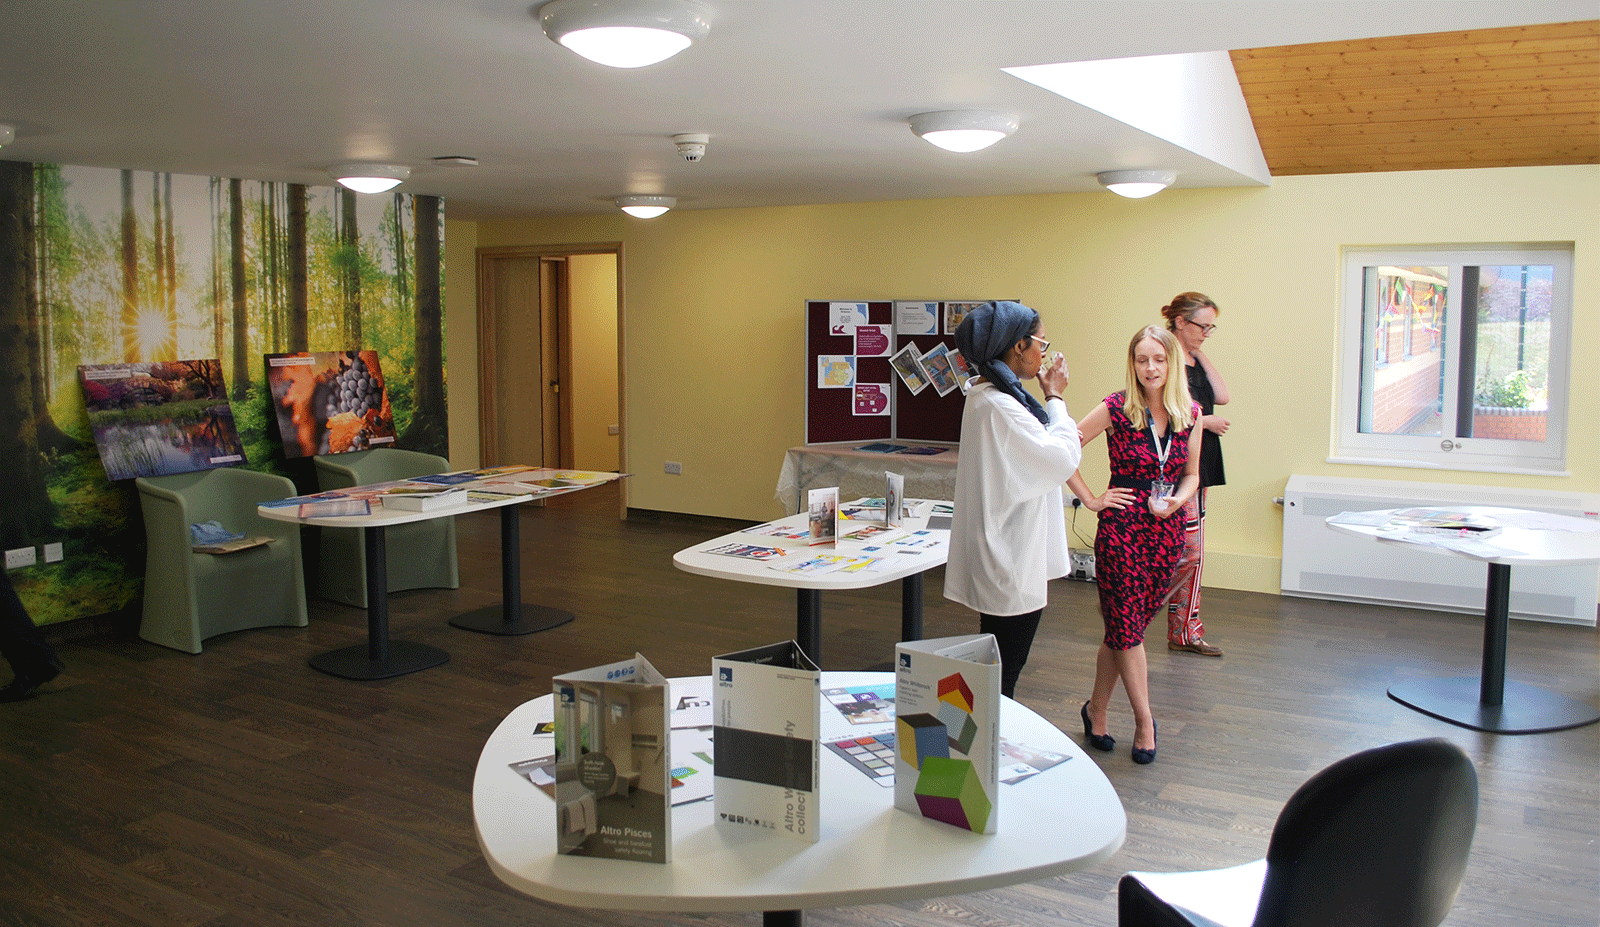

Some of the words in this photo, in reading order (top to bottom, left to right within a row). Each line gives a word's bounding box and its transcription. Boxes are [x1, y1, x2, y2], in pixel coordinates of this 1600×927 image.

[785, 803, 794, 832] Altro
[600, 825, 622, 836] Altro
[624, 827, 652, 839] Pisces
